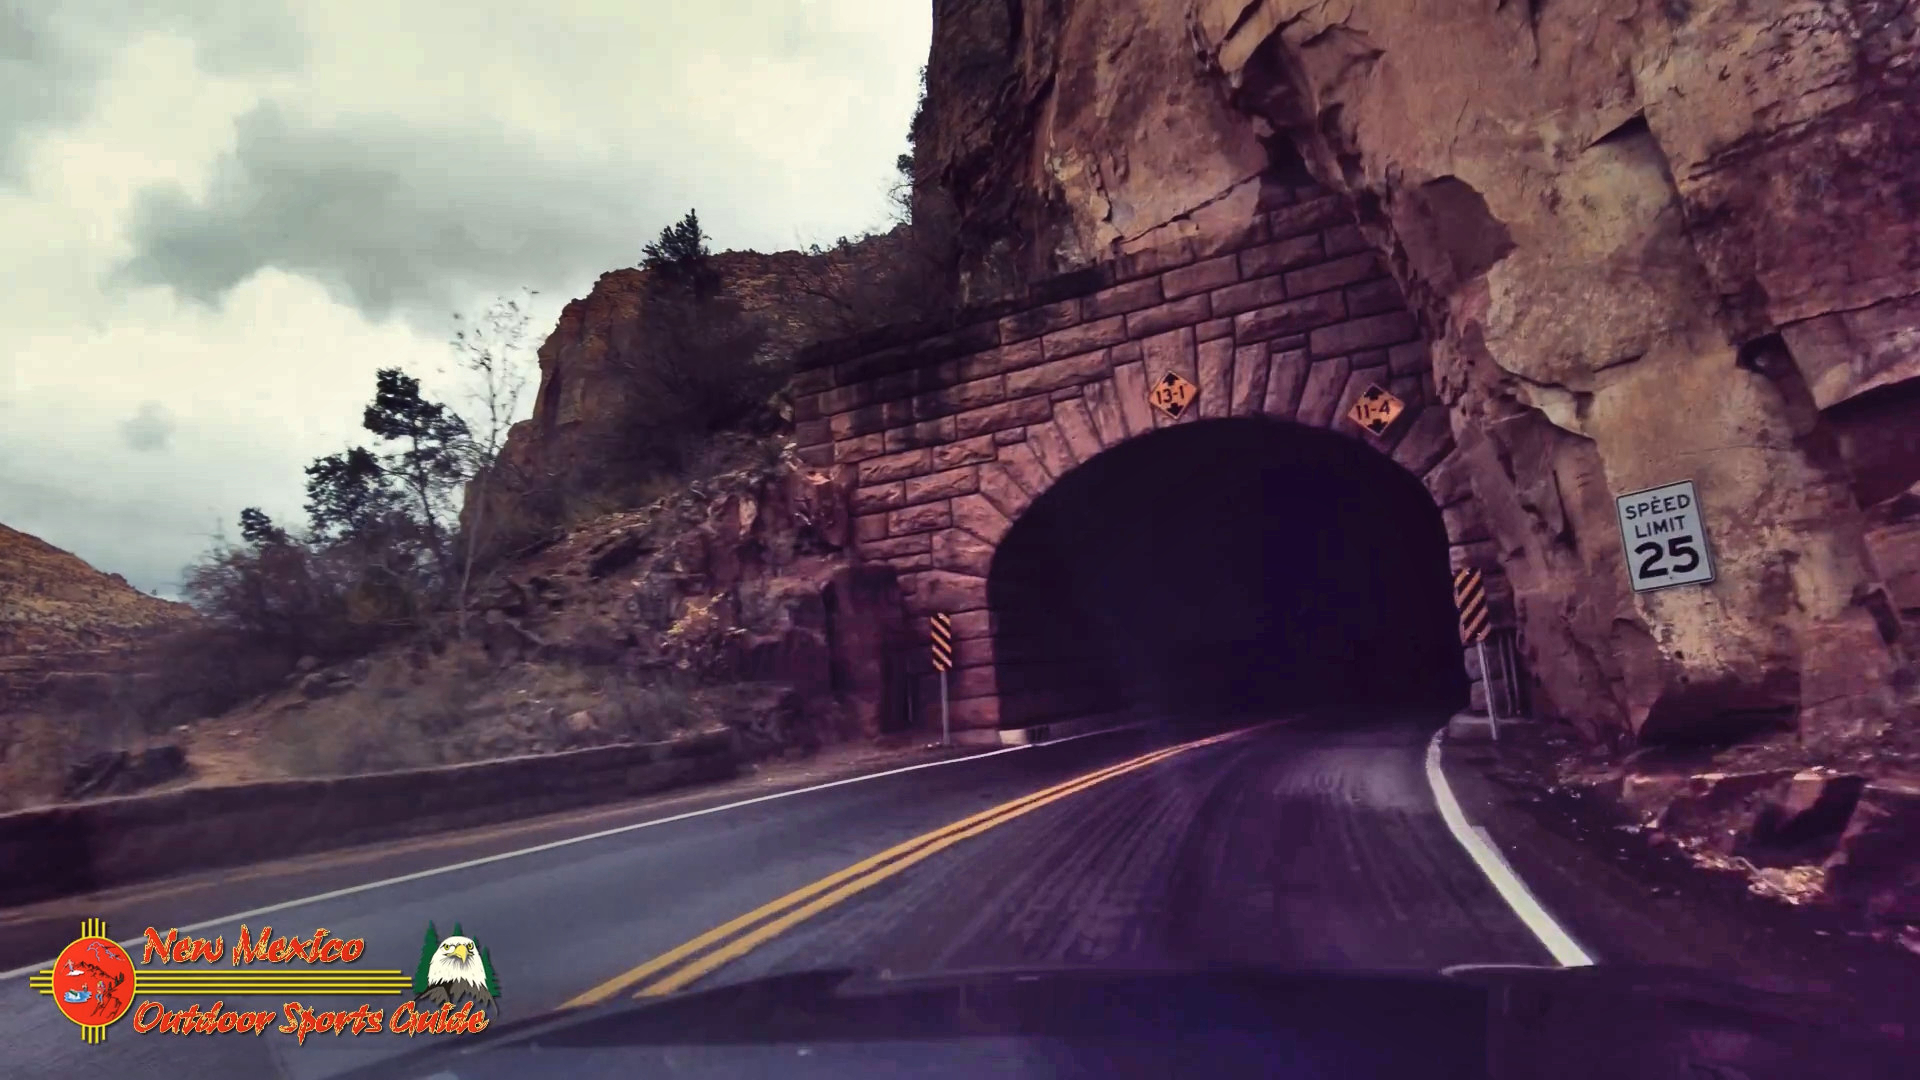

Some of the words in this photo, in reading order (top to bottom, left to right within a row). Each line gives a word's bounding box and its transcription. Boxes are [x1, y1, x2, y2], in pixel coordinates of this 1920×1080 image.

[1625, 494, 1691, 520] SPEED
[1635, 515, 1685, 538] LIMIT
[1634, 535, 1699, 579] 25
